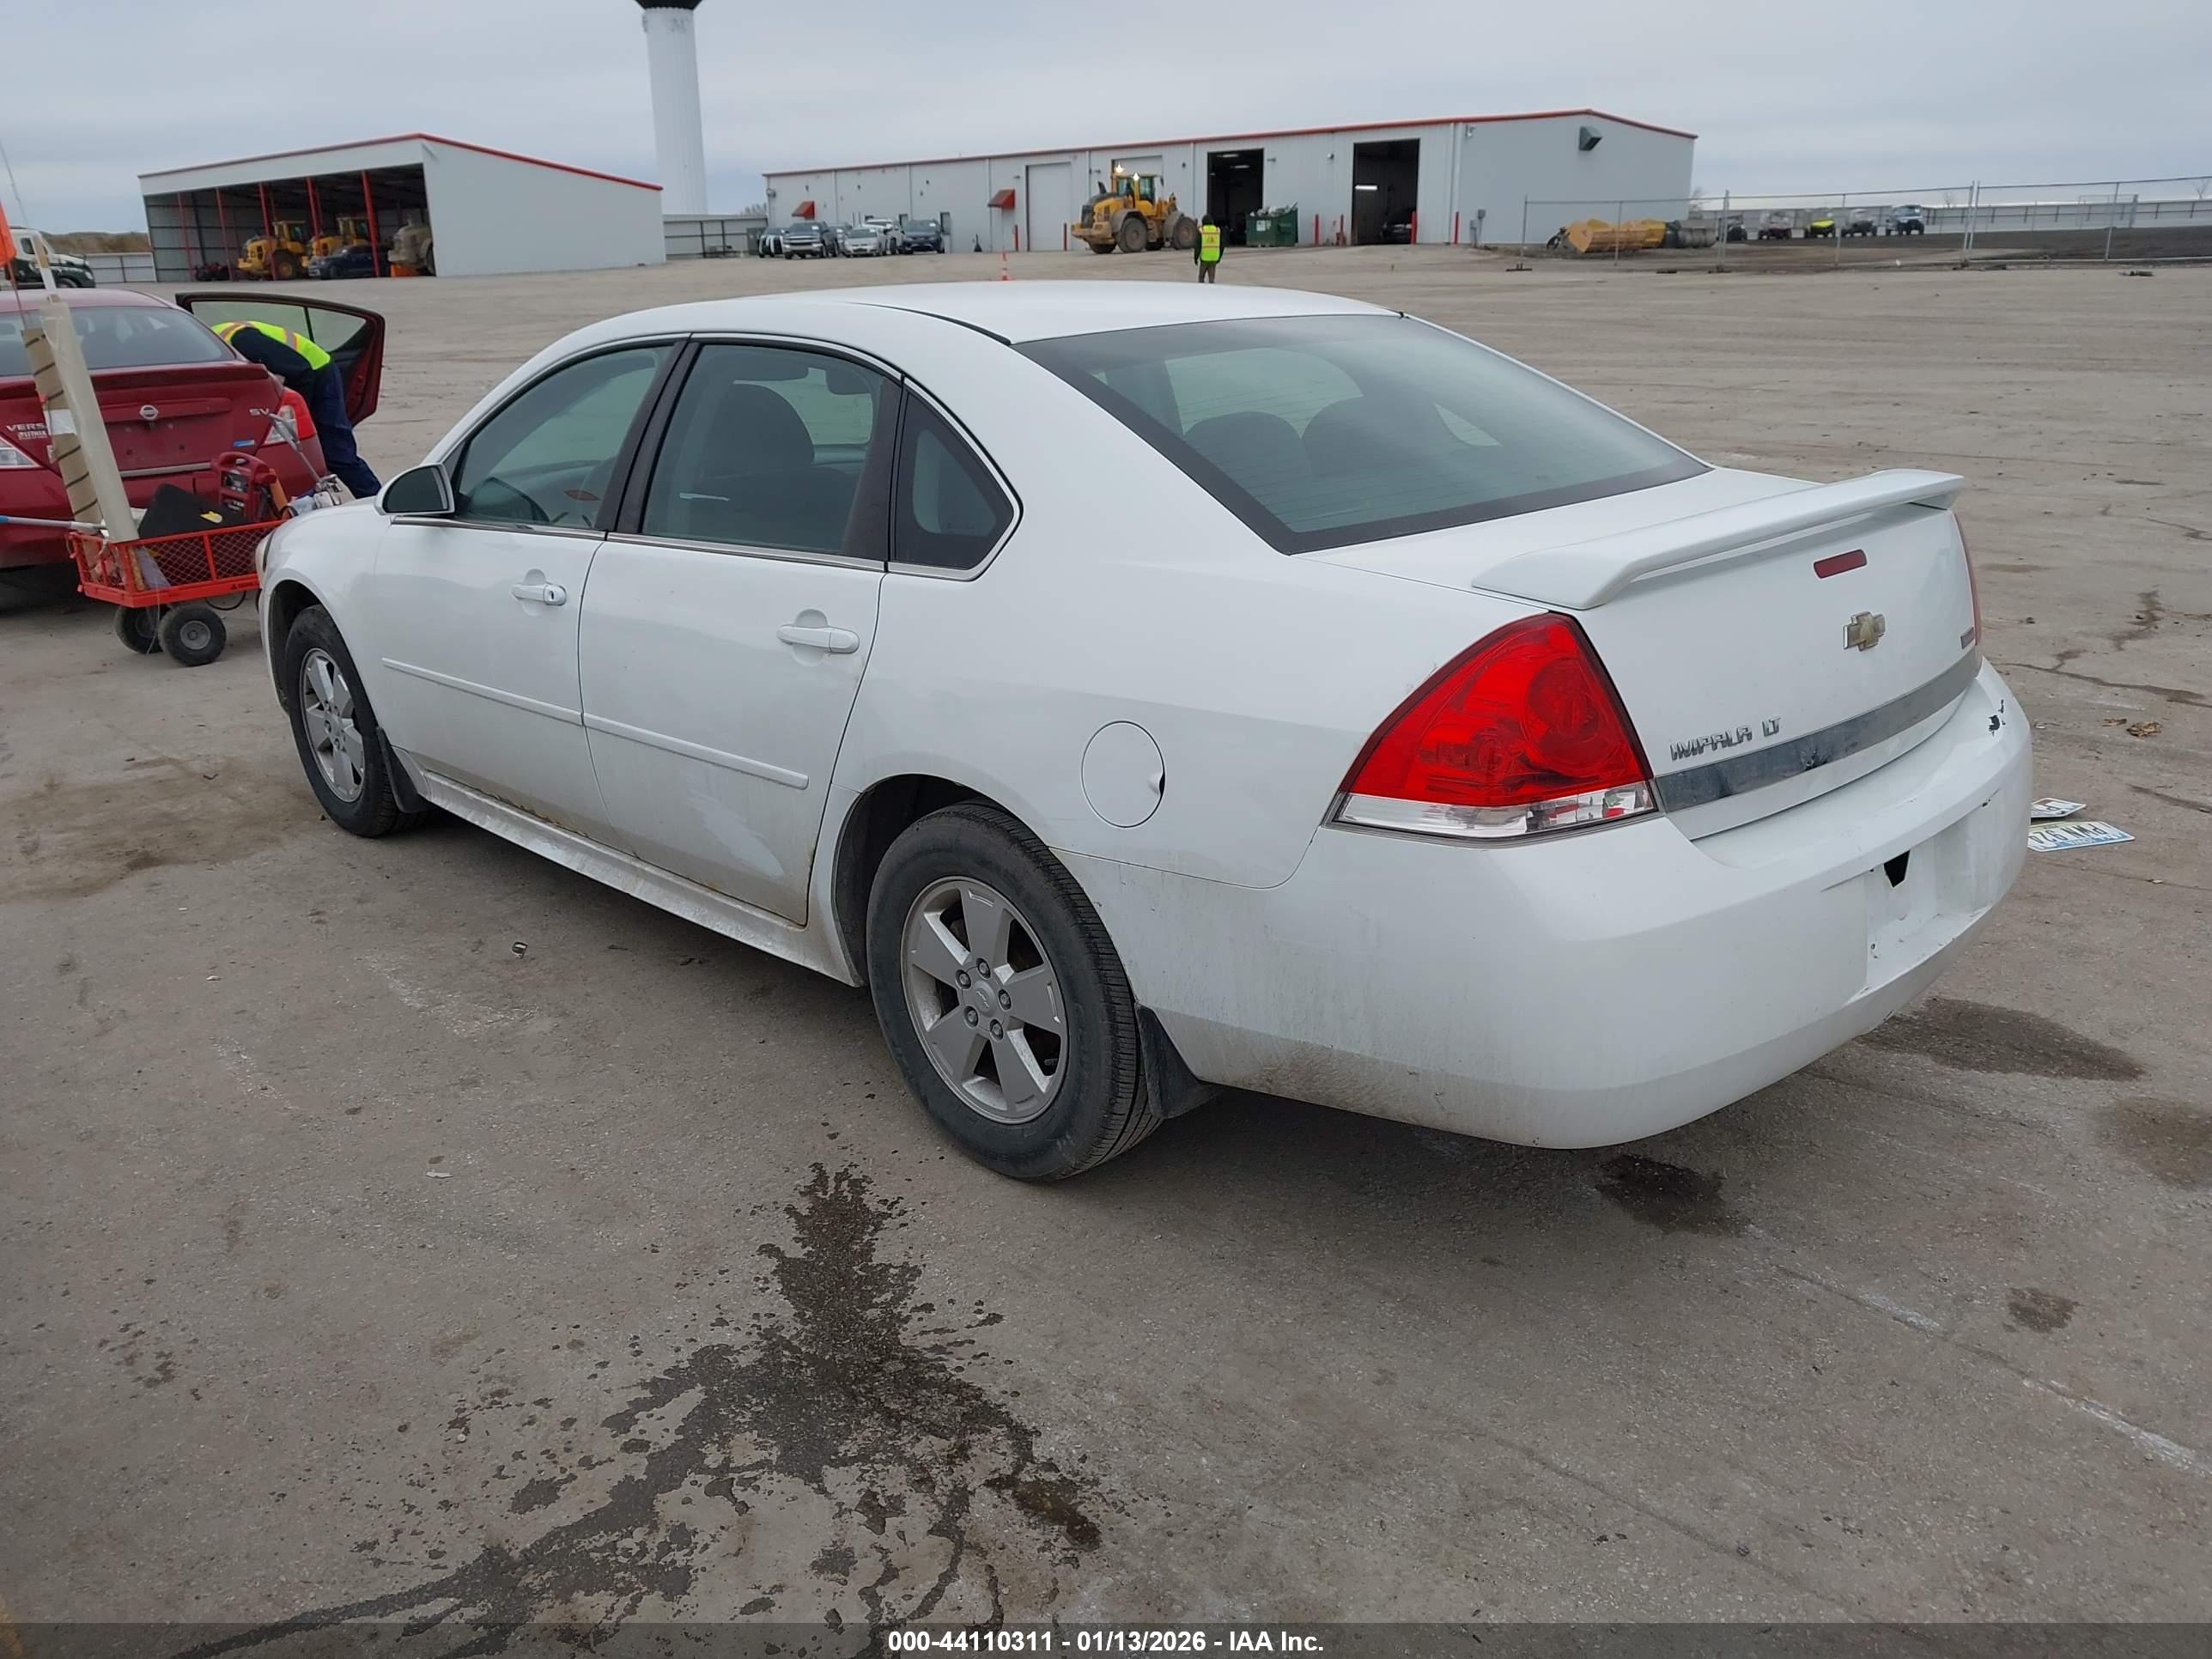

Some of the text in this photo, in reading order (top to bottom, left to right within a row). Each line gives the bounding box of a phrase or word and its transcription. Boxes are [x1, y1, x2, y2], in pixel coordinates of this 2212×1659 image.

[6, 422, 46, 432] VERS
[1670, 715, 1782, 761] IMPALA LT
[2061, 823, 2108, 839] PWN
